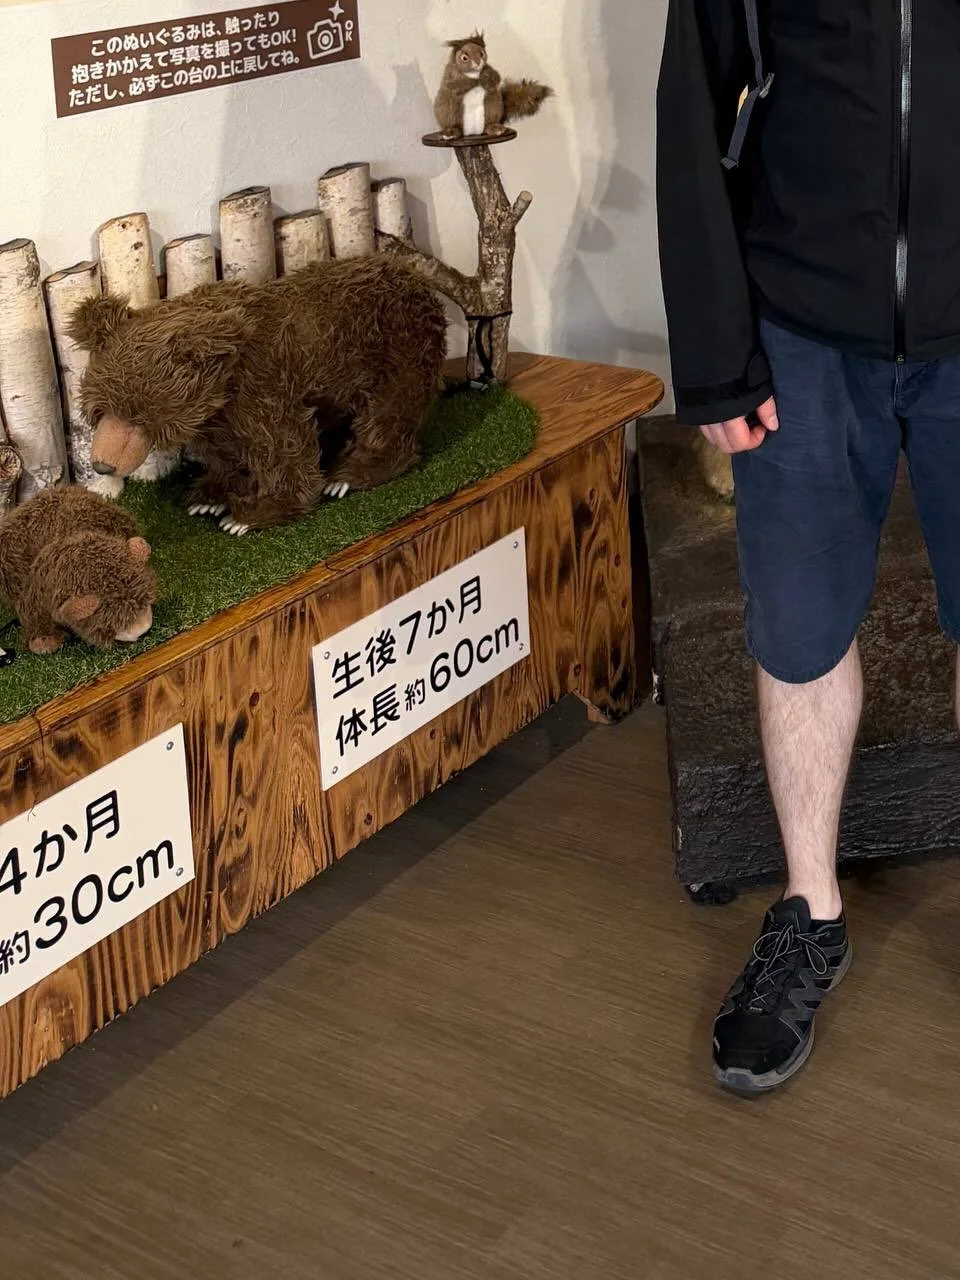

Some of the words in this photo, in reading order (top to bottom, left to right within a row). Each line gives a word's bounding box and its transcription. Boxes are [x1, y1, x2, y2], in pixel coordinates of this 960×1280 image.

[71, 30, 297, 85] 抱きかかえて写真を撮ってもOK!
[90, 10, 280, 57] このぬいぐるみは、触ったり
[68, 49, 300, 108] ただし、必ずこの台の上に戻してね。
[331, 575, 482, 699] 生後7か月
[335, 617, 519, 757] 体長約60cm
[0, 789, 120, 895] 4か月
